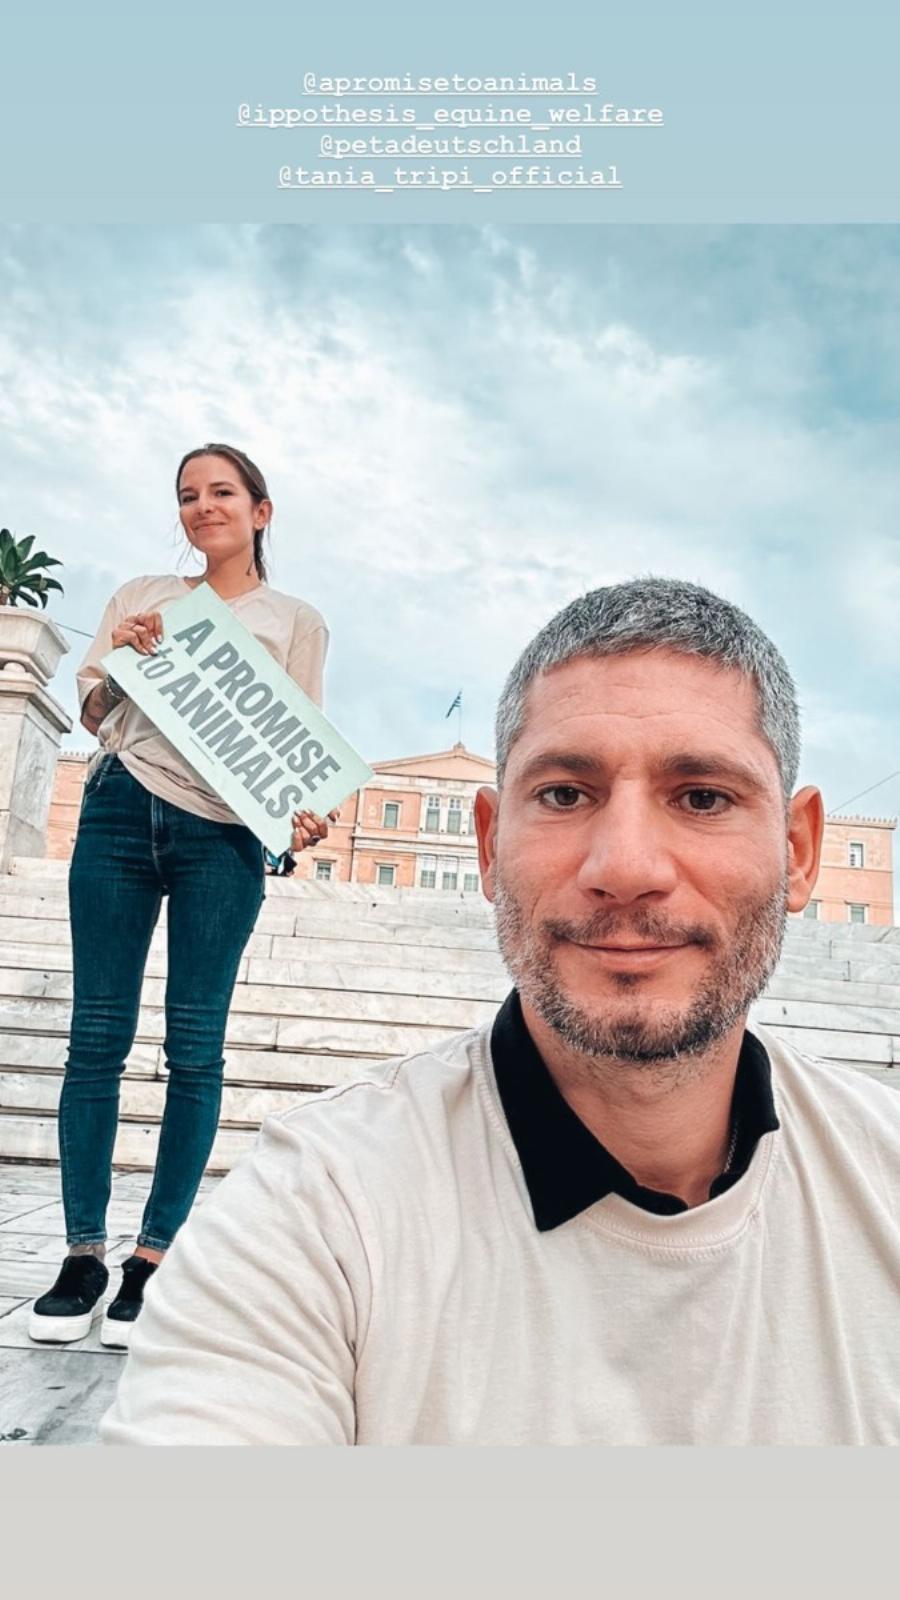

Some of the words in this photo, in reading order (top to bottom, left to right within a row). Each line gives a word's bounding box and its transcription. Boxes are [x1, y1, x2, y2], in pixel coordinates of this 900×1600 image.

[136, 647, 175, 680] to
[158, 671, 303, 820] ANIMALS
[173, 618, 216, 656] A
[198, 641, 342, 793] PROMISE
